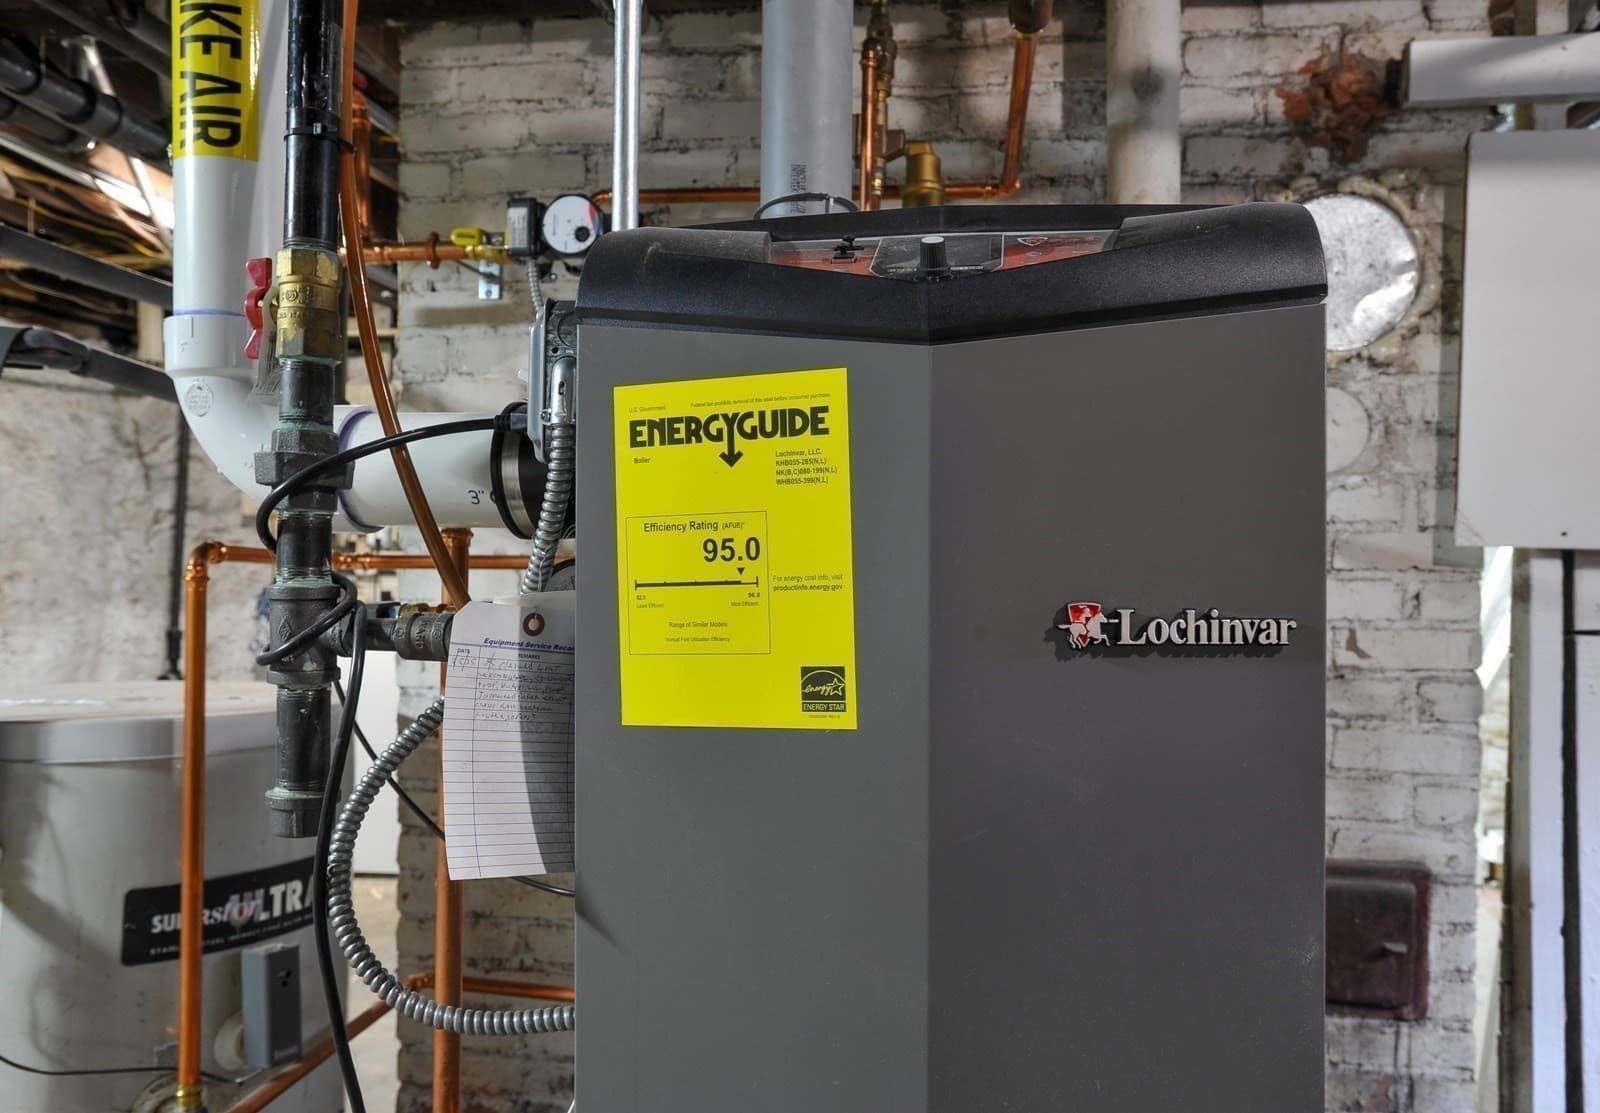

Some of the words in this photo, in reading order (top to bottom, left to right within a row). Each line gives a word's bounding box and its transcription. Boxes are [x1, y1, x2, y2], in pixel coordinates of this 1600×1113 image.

[180, 0, 242, 59] KE
[180, 70, 242, 150] AIR
[629, 405, 830, 450] ENERGYGUIDE
[633, 456, 651, 465] Boiler
[467, 489, 485, 505] 3"
[643, 522, 687, 534] Efficiency
[689, 520, 719, 532] Rating
[702, 536, 761, 562] 95.0
[784, 575, 803, 583] energy
[804, 574, 817, 582] cost
[831, 572, 843, 580] visit
[772, 583, 843, 592] productinfo.energy.gov
[668, 621, 685, 630] Range
[692, 620, 709, 628] Similar
[710, 620, 728, 628] Models
[1116, 608, 1297, 646] Lochinvar
[483, 637, 524, 647] Equipment
[525, 641, 552, 650] Service
[803, 703, 828, 711] ENERGY
[828, 703, 845, 711] STAR
